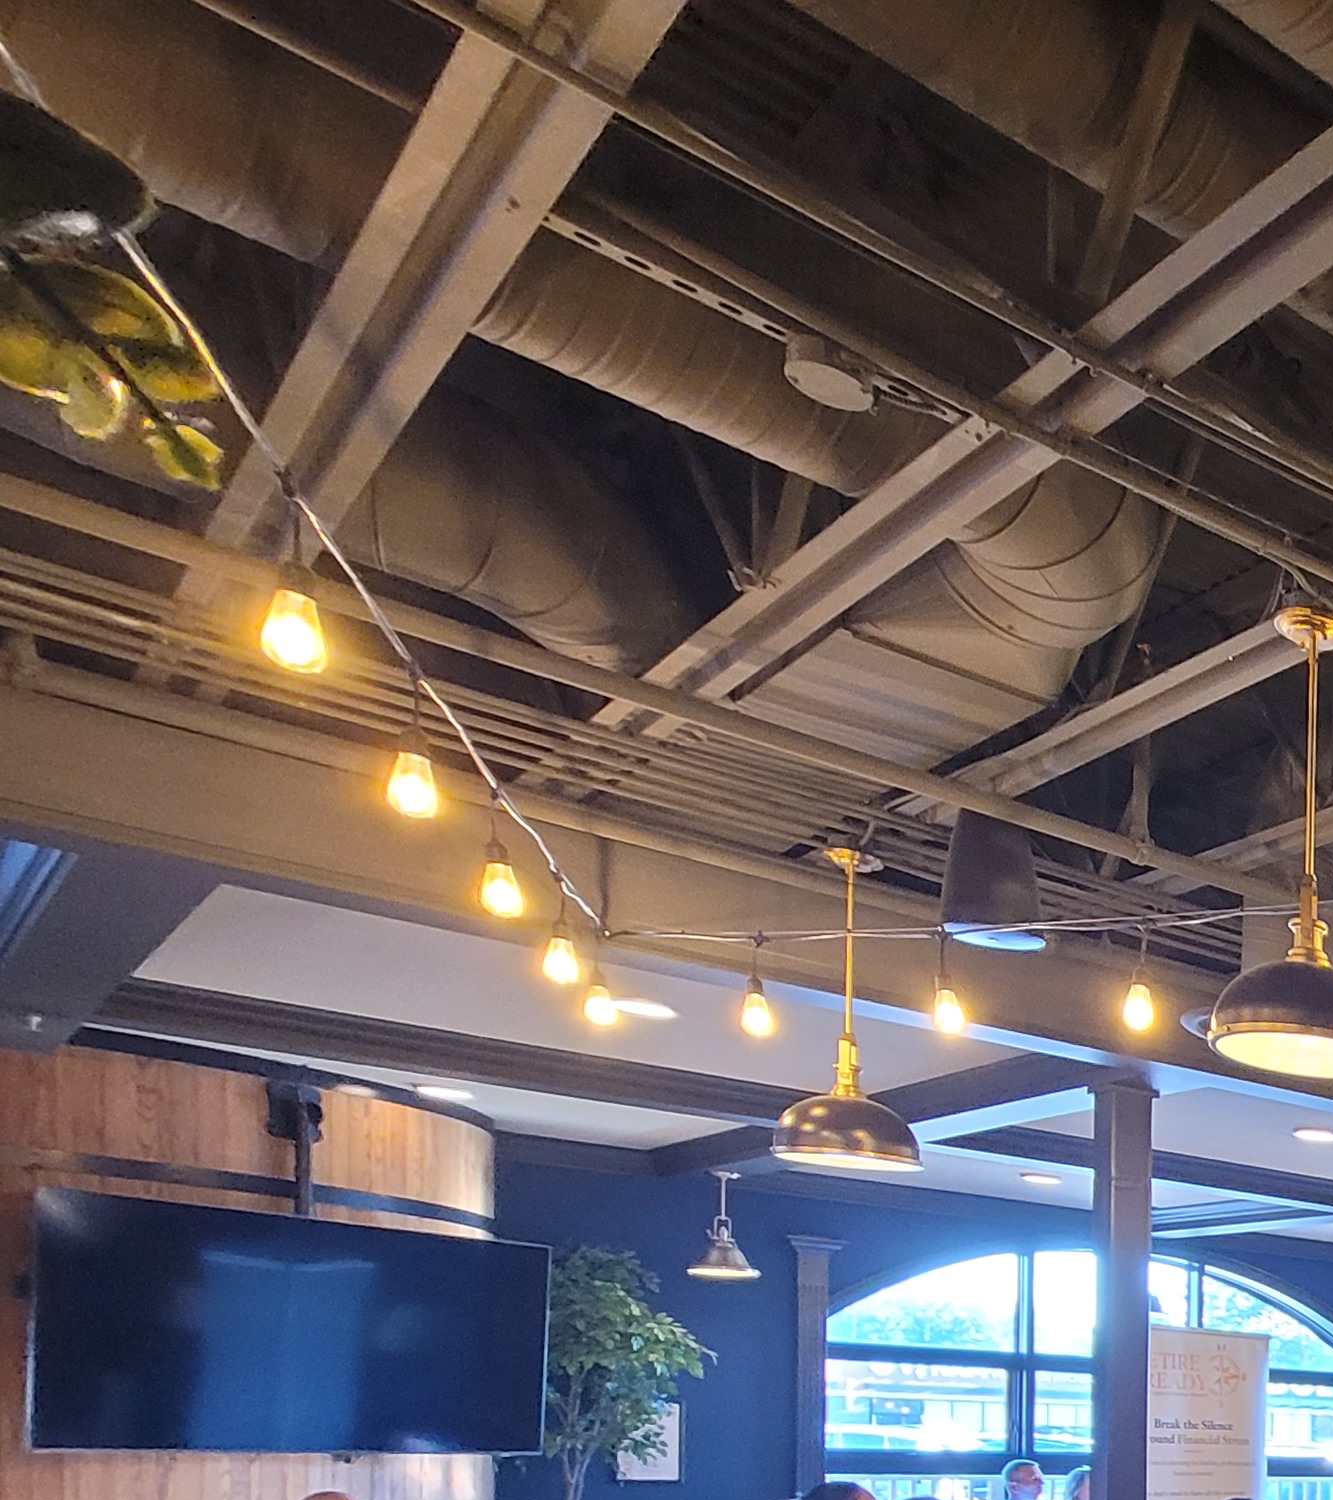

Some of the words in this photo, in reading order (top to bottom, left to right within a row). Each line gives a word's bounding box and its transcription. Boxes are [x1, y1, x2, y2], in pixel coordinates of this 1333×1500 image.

[1150, 1352, 1200, 1371] ETIRE
[1154, 1418, 1181, 1429] Break
[1184, 1419, 1199, 1430] the
[1201, 1420, 1233, 1431] Silence
[1178, 1434, 1220, 1445] Financial
